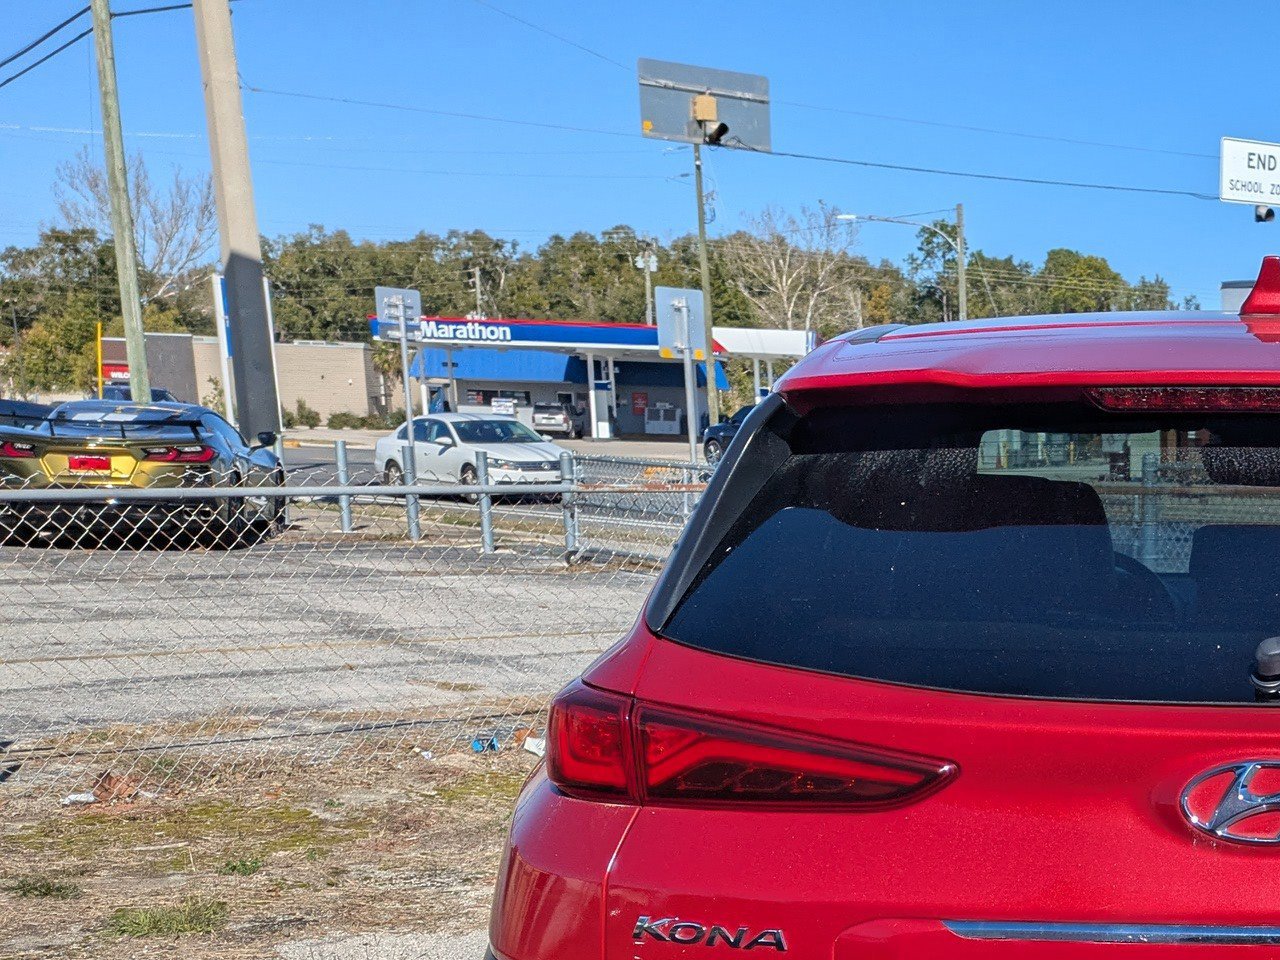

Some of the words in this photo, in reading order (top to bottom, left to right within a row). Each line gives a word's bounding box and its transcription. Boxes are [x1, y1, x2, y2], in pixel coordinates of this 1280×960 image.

[1247, 152, 1277, 171] END
[1229, 179, 1264, 194] SCHOOL
[420, 320, 512, 340] Marathon
[632, 914, 788, 952] KONA
